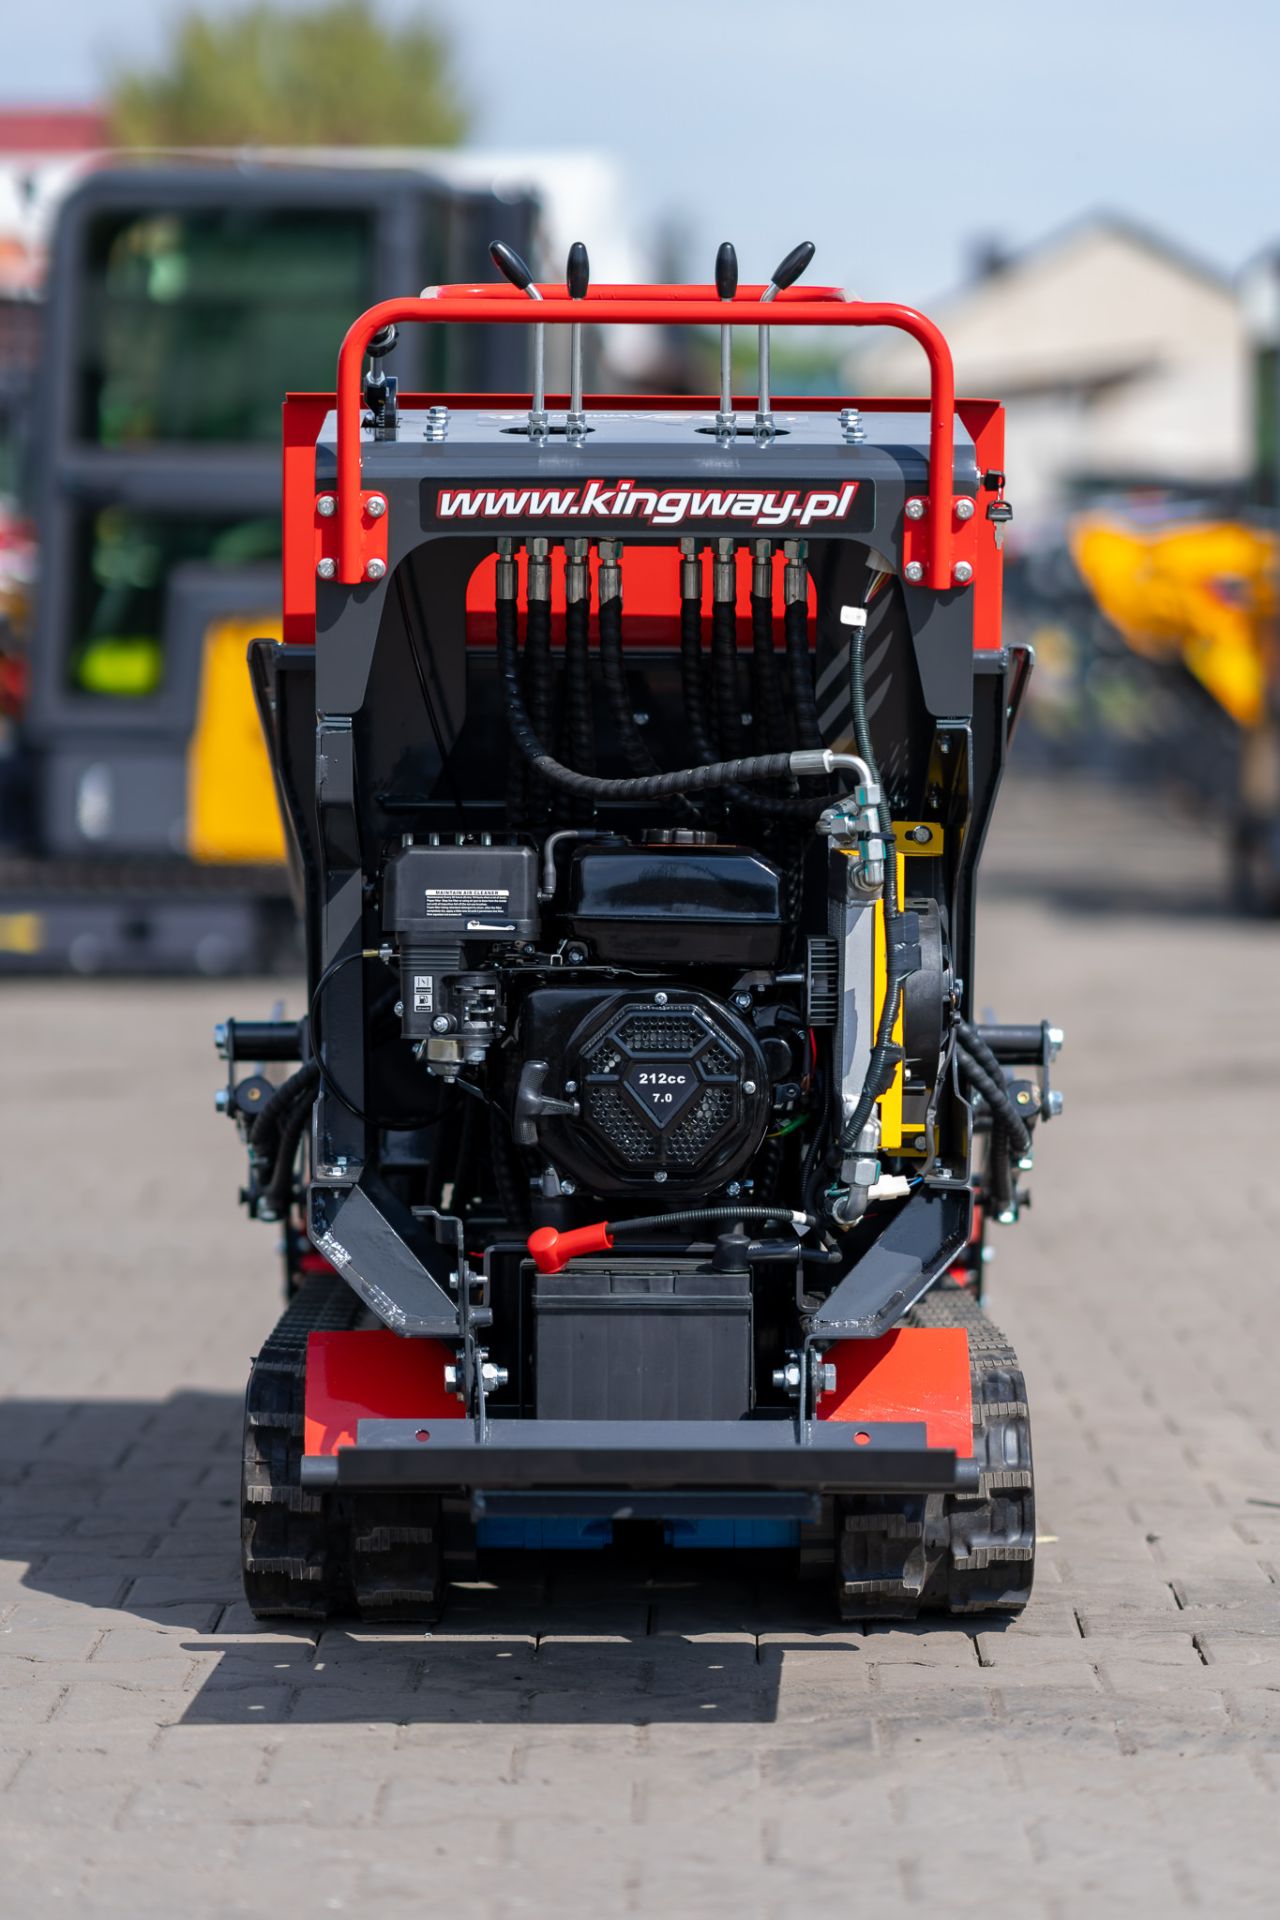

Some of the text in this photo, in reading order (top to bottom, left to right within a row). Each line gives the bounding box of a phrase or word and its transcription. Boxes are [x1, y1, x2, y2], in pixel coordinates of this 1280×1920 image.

[438, 481, 857, 526] www.kingway.pl
[639, 1073, 686, 1084] 212cc
[652, 1093, 673, 1103] 7.0
